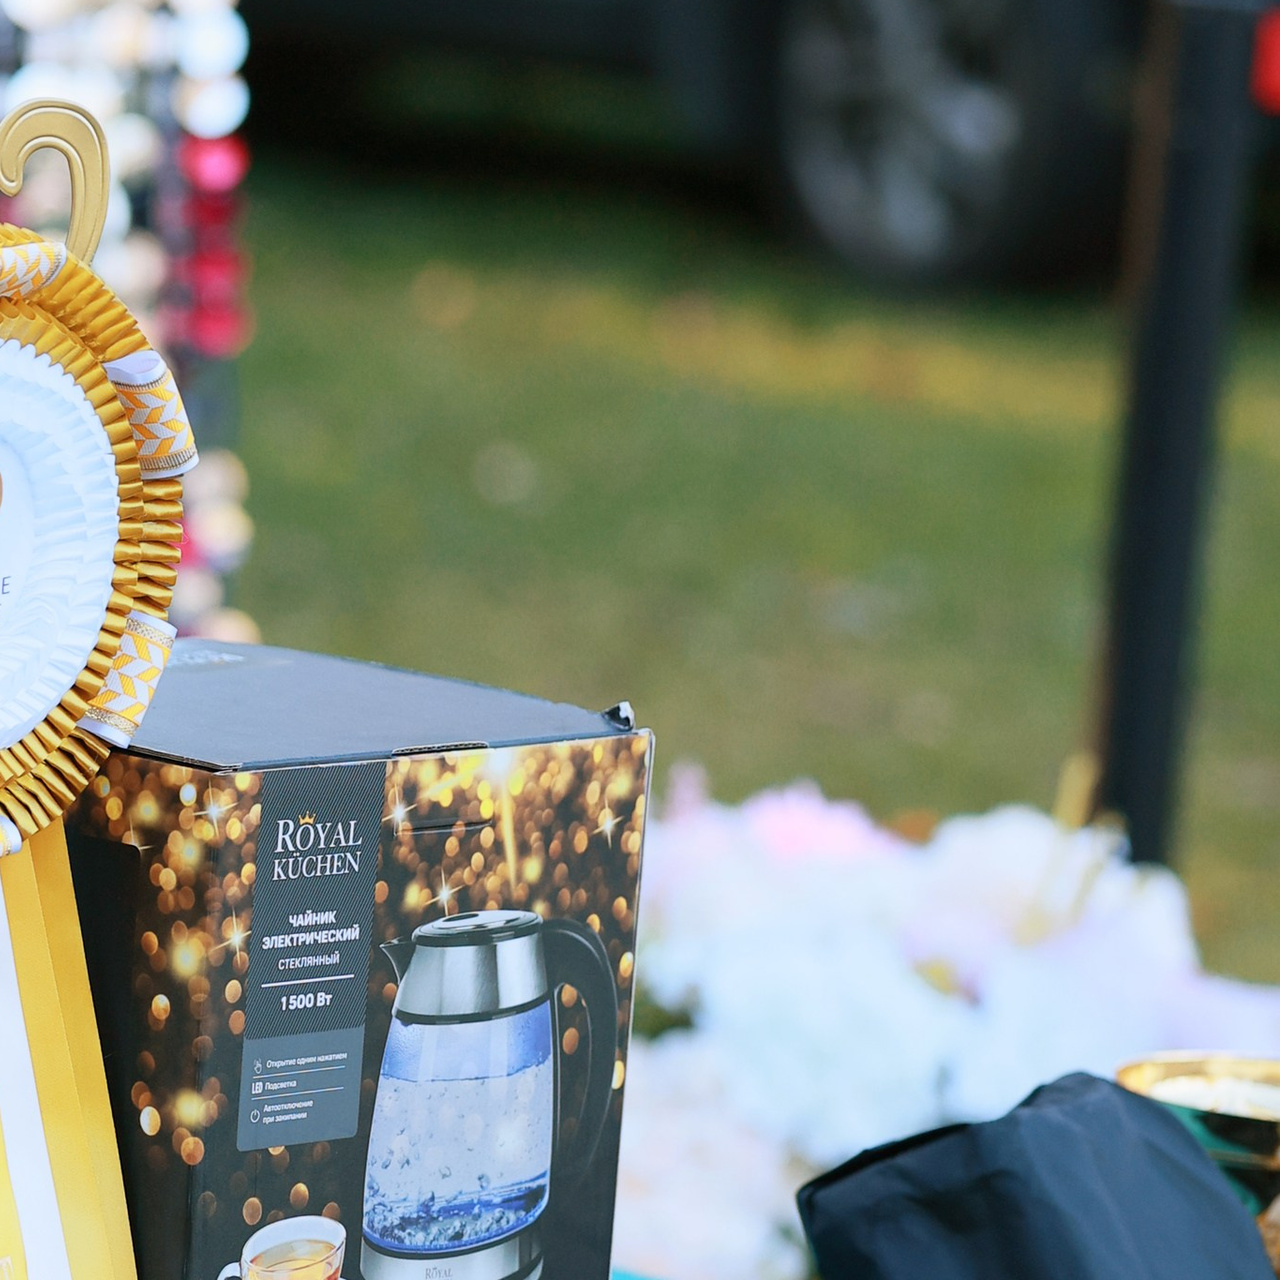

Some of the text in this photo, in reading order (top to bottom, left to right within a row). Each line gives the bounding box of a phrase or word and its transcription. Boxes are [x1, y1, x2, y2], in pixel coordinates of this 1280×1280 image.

[272, 851, 362, 881] KÜCHEN
[289, 910, 337, 928] ЧАЙНИК
[262, 924, 360, 950] ЭЛЕКТРИЧЕСКИЙ
[278, 951, 340, 970] СТЕКЛЯННЫЙ
[281, 992, 333, 1010] 1500 Вт
[251, 1081, 263, 1094] LED
